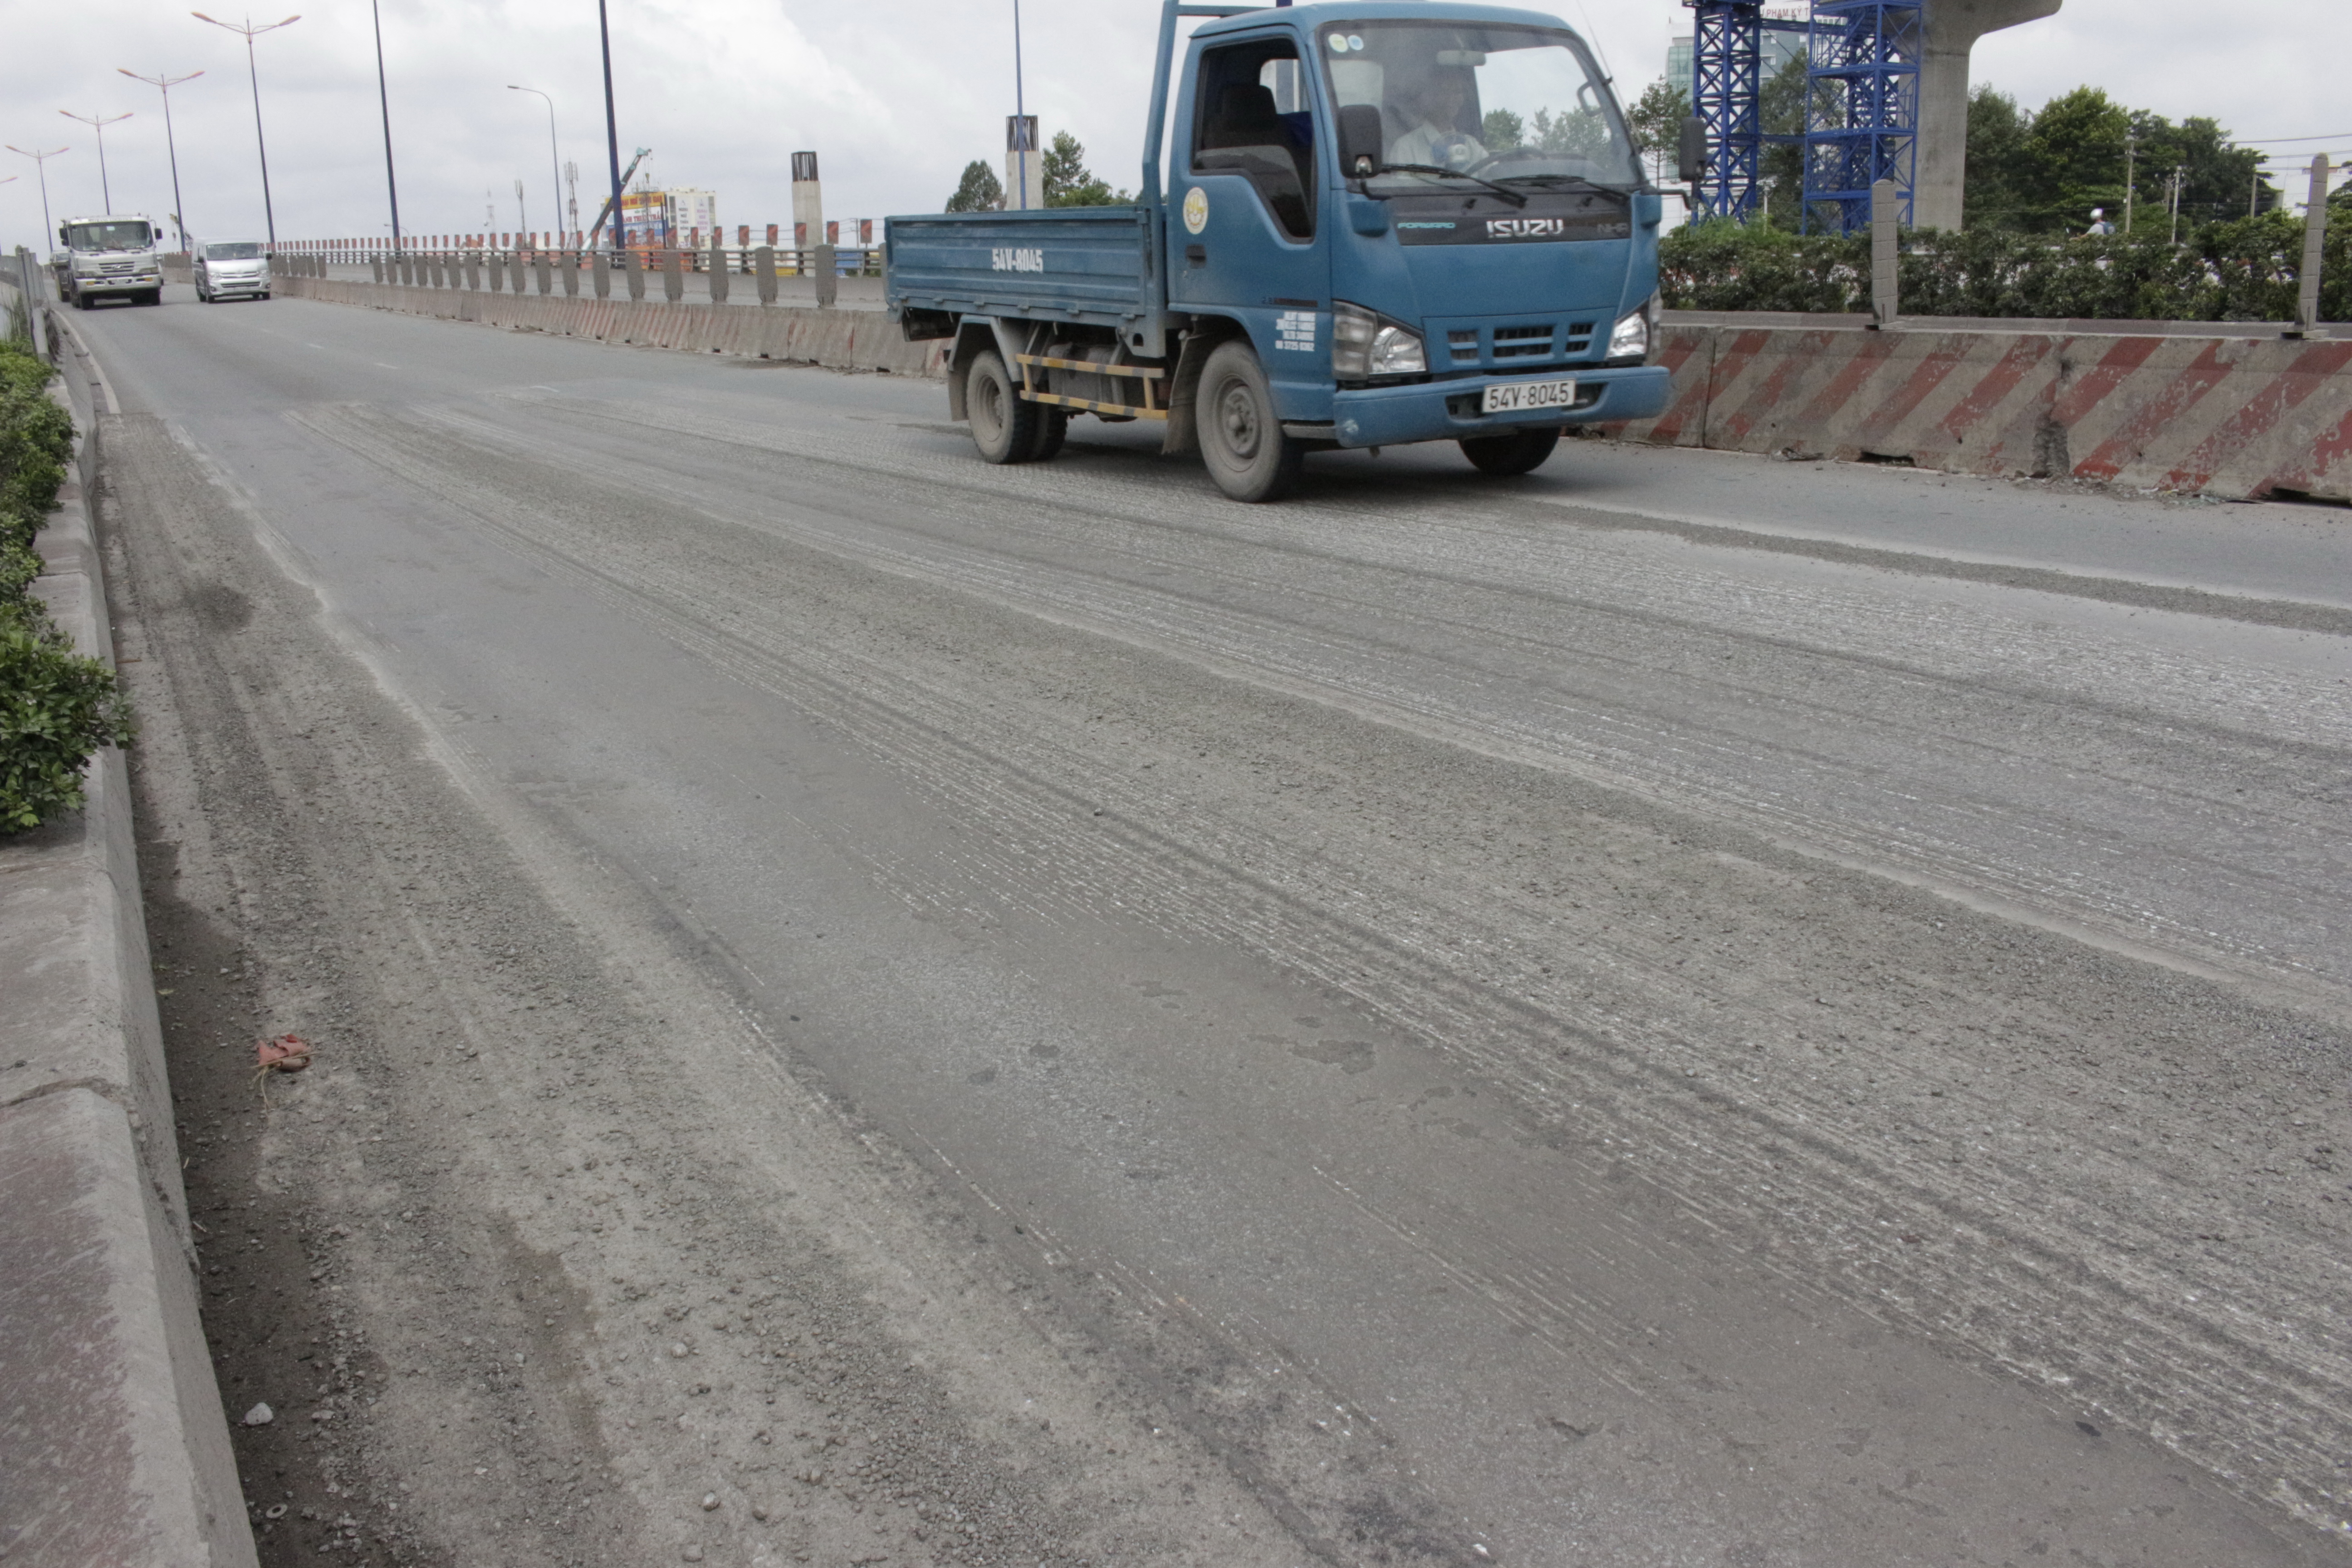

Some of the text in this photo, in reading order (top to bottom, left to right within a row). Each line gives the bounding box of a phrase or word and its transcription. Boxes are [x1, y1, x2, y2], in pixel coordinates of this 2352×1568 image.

[1486, 219, 1564, 238] ISUZU
[992, 248, 1043, 273] 54V-8045
[1490, 382, 1568, 409] 54V-8045
